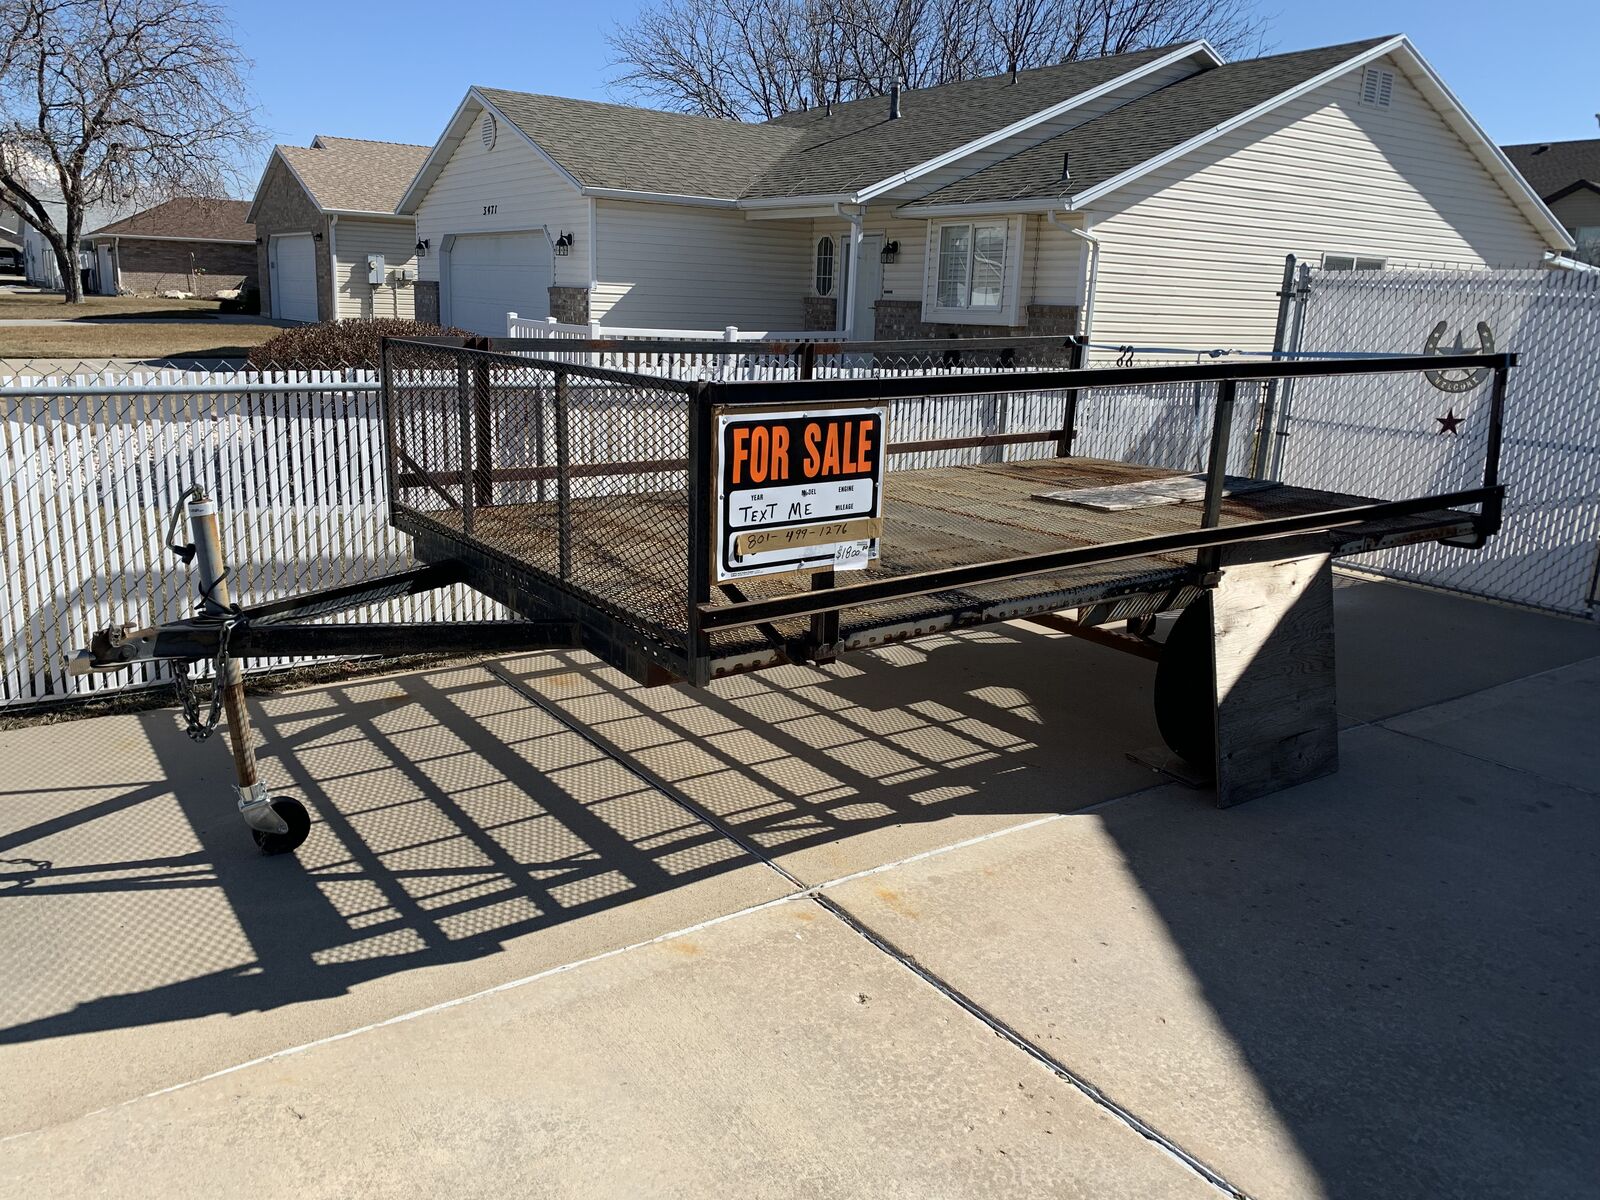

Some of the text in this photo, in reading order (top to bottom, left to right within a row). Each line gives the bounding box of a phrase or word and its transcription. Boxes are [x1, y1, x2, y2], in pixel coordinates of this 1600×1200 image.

[732, 420, 874, 484] FOR SALE
[838, 485, 854, 493] ENGINE
[738, 502, 813, 522] TEXT ME
[835, 503, 854, 511] MILEAGE
